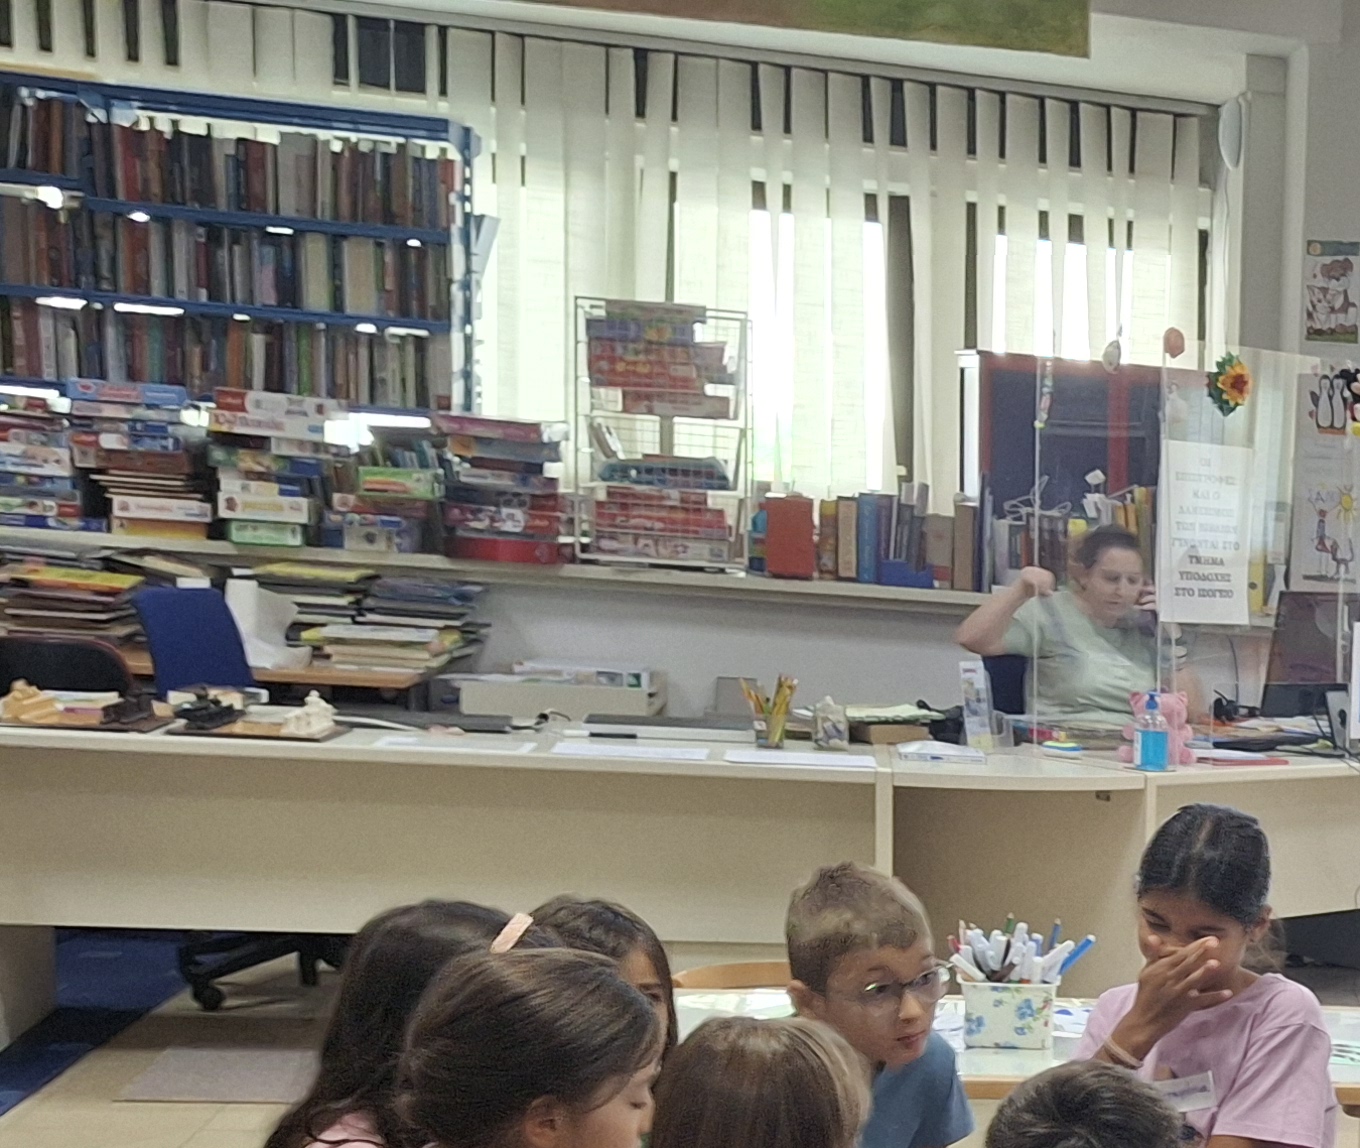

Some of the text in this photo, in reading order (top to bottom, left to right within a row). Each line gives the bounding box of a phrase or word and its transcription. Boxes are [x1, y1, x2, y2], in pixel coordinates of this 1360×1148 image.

[1188, 554, 1225, 566] ΤΜΗΜΑ
[1178, 570, 1232, 583] ΥΠΟΔΟΧΗΣ
[1174, 586, 1195, 597] ΣΤΟ
